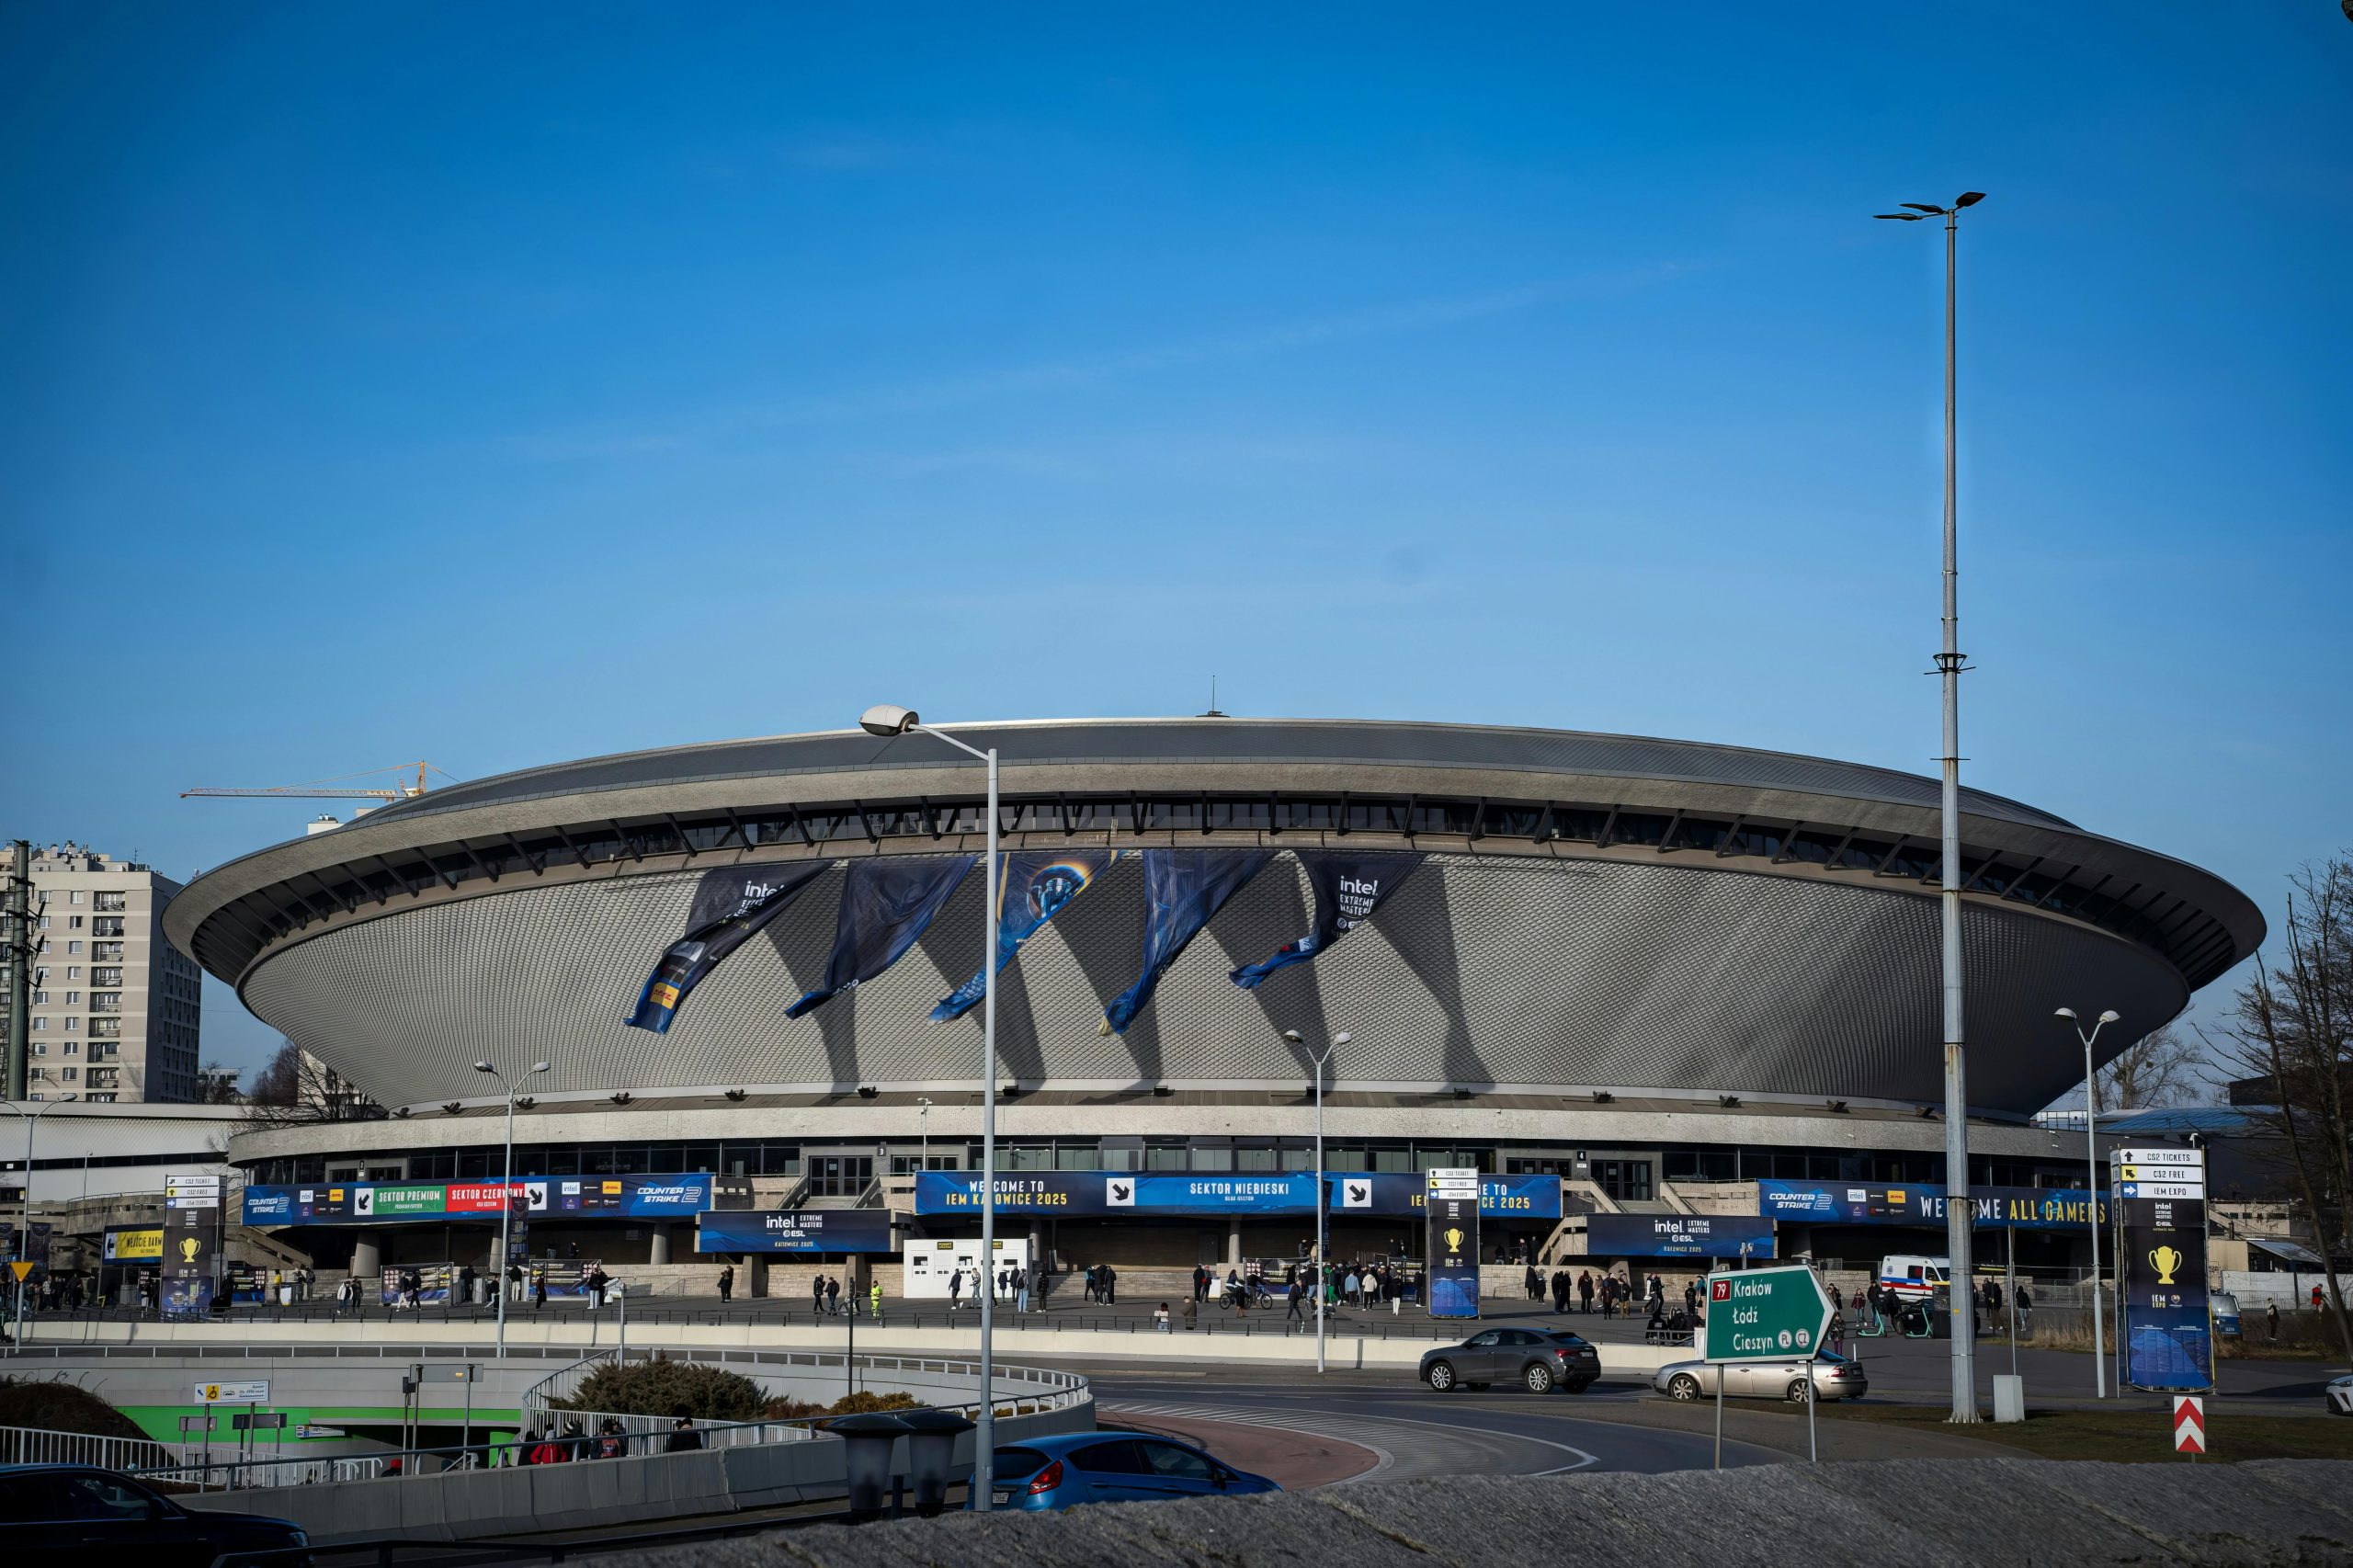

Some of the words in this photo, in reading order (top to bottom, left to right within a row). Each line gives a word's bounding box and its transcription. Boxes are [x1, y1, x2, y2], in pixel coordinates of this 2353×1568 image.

[745, 881, 784, 898] inte
[2147, 1153, 2160, 1161] CS2
[2163, 1153, 2190, 1162] TICKETS
[637, 1187, 683, 1195] COUNTER
[969, 1180, 1025, 1192] WECOME
[1030, 1180, 1044, 1192] TO
[1189, 1183, 1231, 1195] SEKTOR
[1235, 1183, 1289, 1195] NIEBIESKI
[1494, 1184, 1507, 1196] TO
[2169, 1187, 2187, 1196] EXPO
[379, 1191, 405, 1202] SEKTOR
[407, 1190, 440, 1201] PREMIUM
[451, 1189, 480, 1199] SEKTOR
[643, 1195, 678, 1203] STRIKE
[946, 1193, 967, 1205] IEM
[972, 1193, 1031, 1205] KAOWICE
[1037, 1193, 1067, 1205] 2025
[1768, 1193, 1814, 1201] COUNTER
[1501, 1197, 1530, 1209] 2025
[1777, 1201, 1812, 1210] STRIKE
[1920, 1196, 2001, 1220] WEME
[2009, 1199, 2038, 1221] ALL
[1716, 1283, 1727, 1299] 79
[1734, 1278, 1772, 1298] Kraków
[2152, 1294, 2166, 1302] IEM
[1733, 1306, 1758, 1324] Łódź
[1733, 1333, 1773, 1355] Cieszyn
[1781, 1334, 1790, 1345] PL
[1797, 1333, 1807, 1345] CZ
